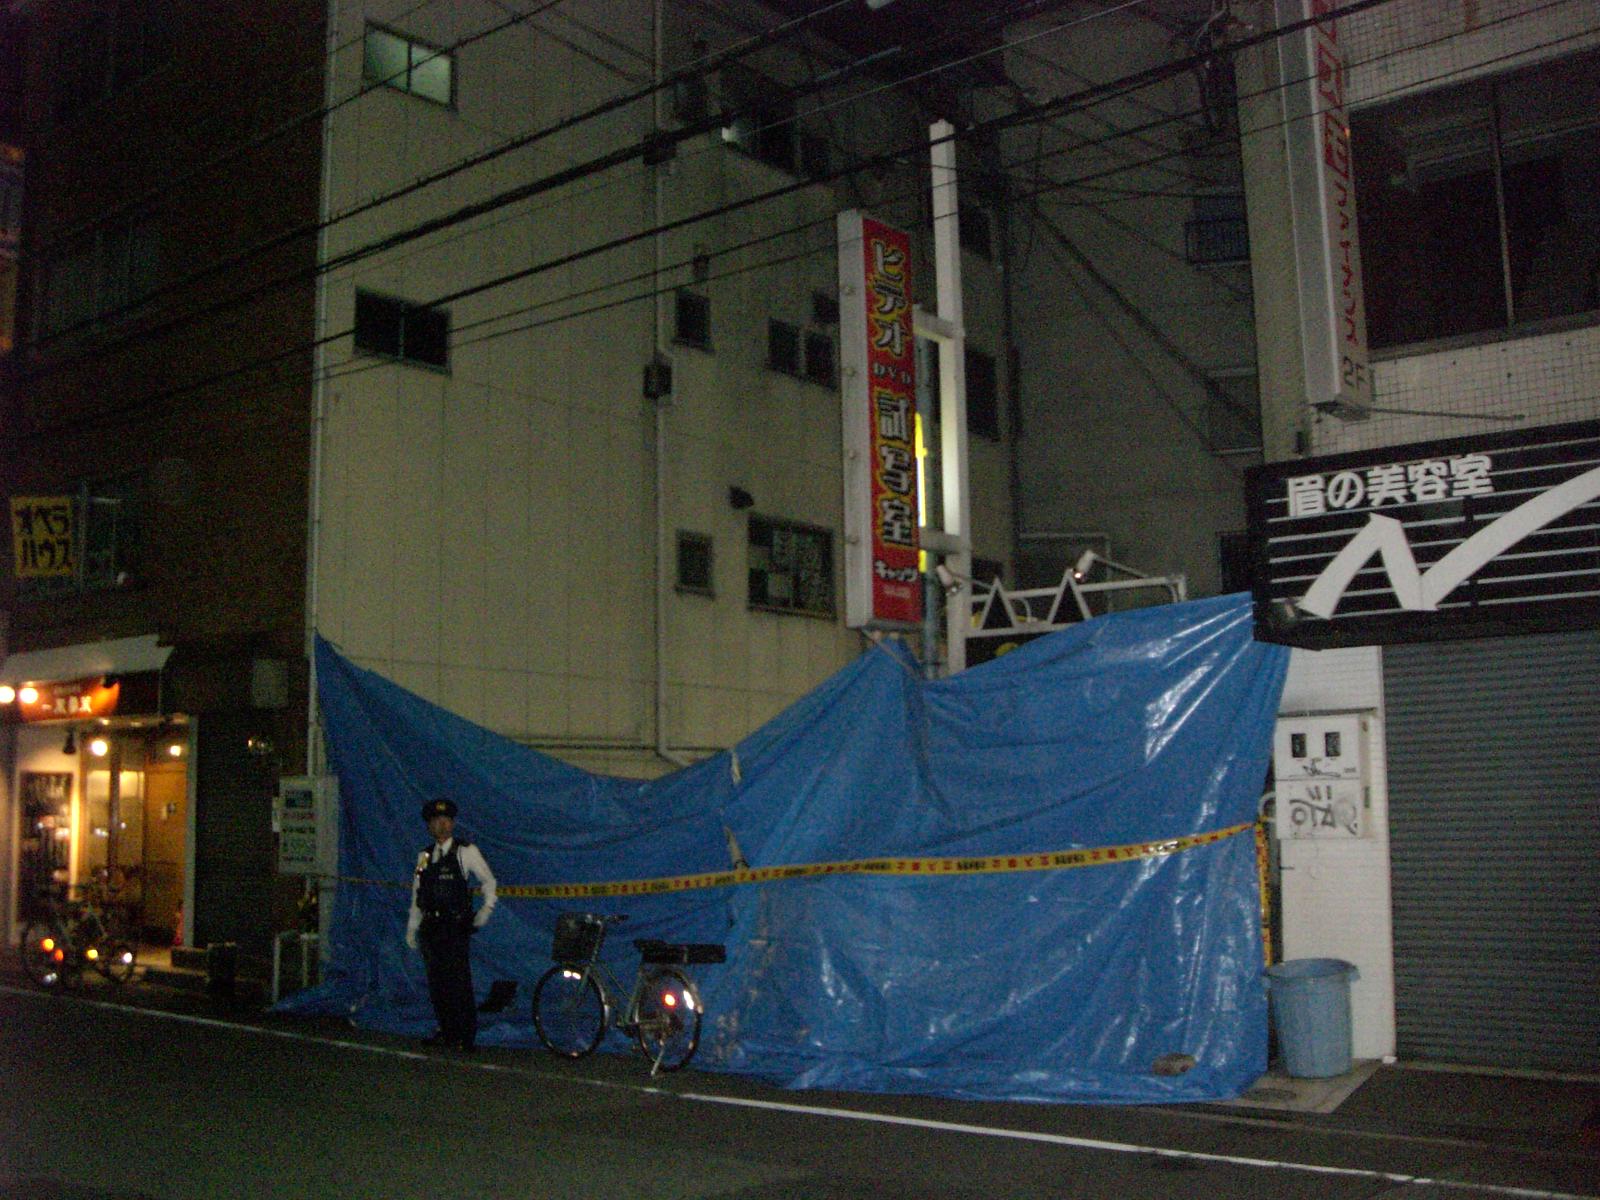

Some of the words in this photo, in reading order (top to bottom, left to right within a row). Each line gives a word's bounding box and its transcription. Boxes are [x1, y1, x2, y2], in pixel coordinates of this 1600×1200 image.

[870, 238, 909, 357] ビデオ
[1285, 453, 1495, 519] 眉の美容室
